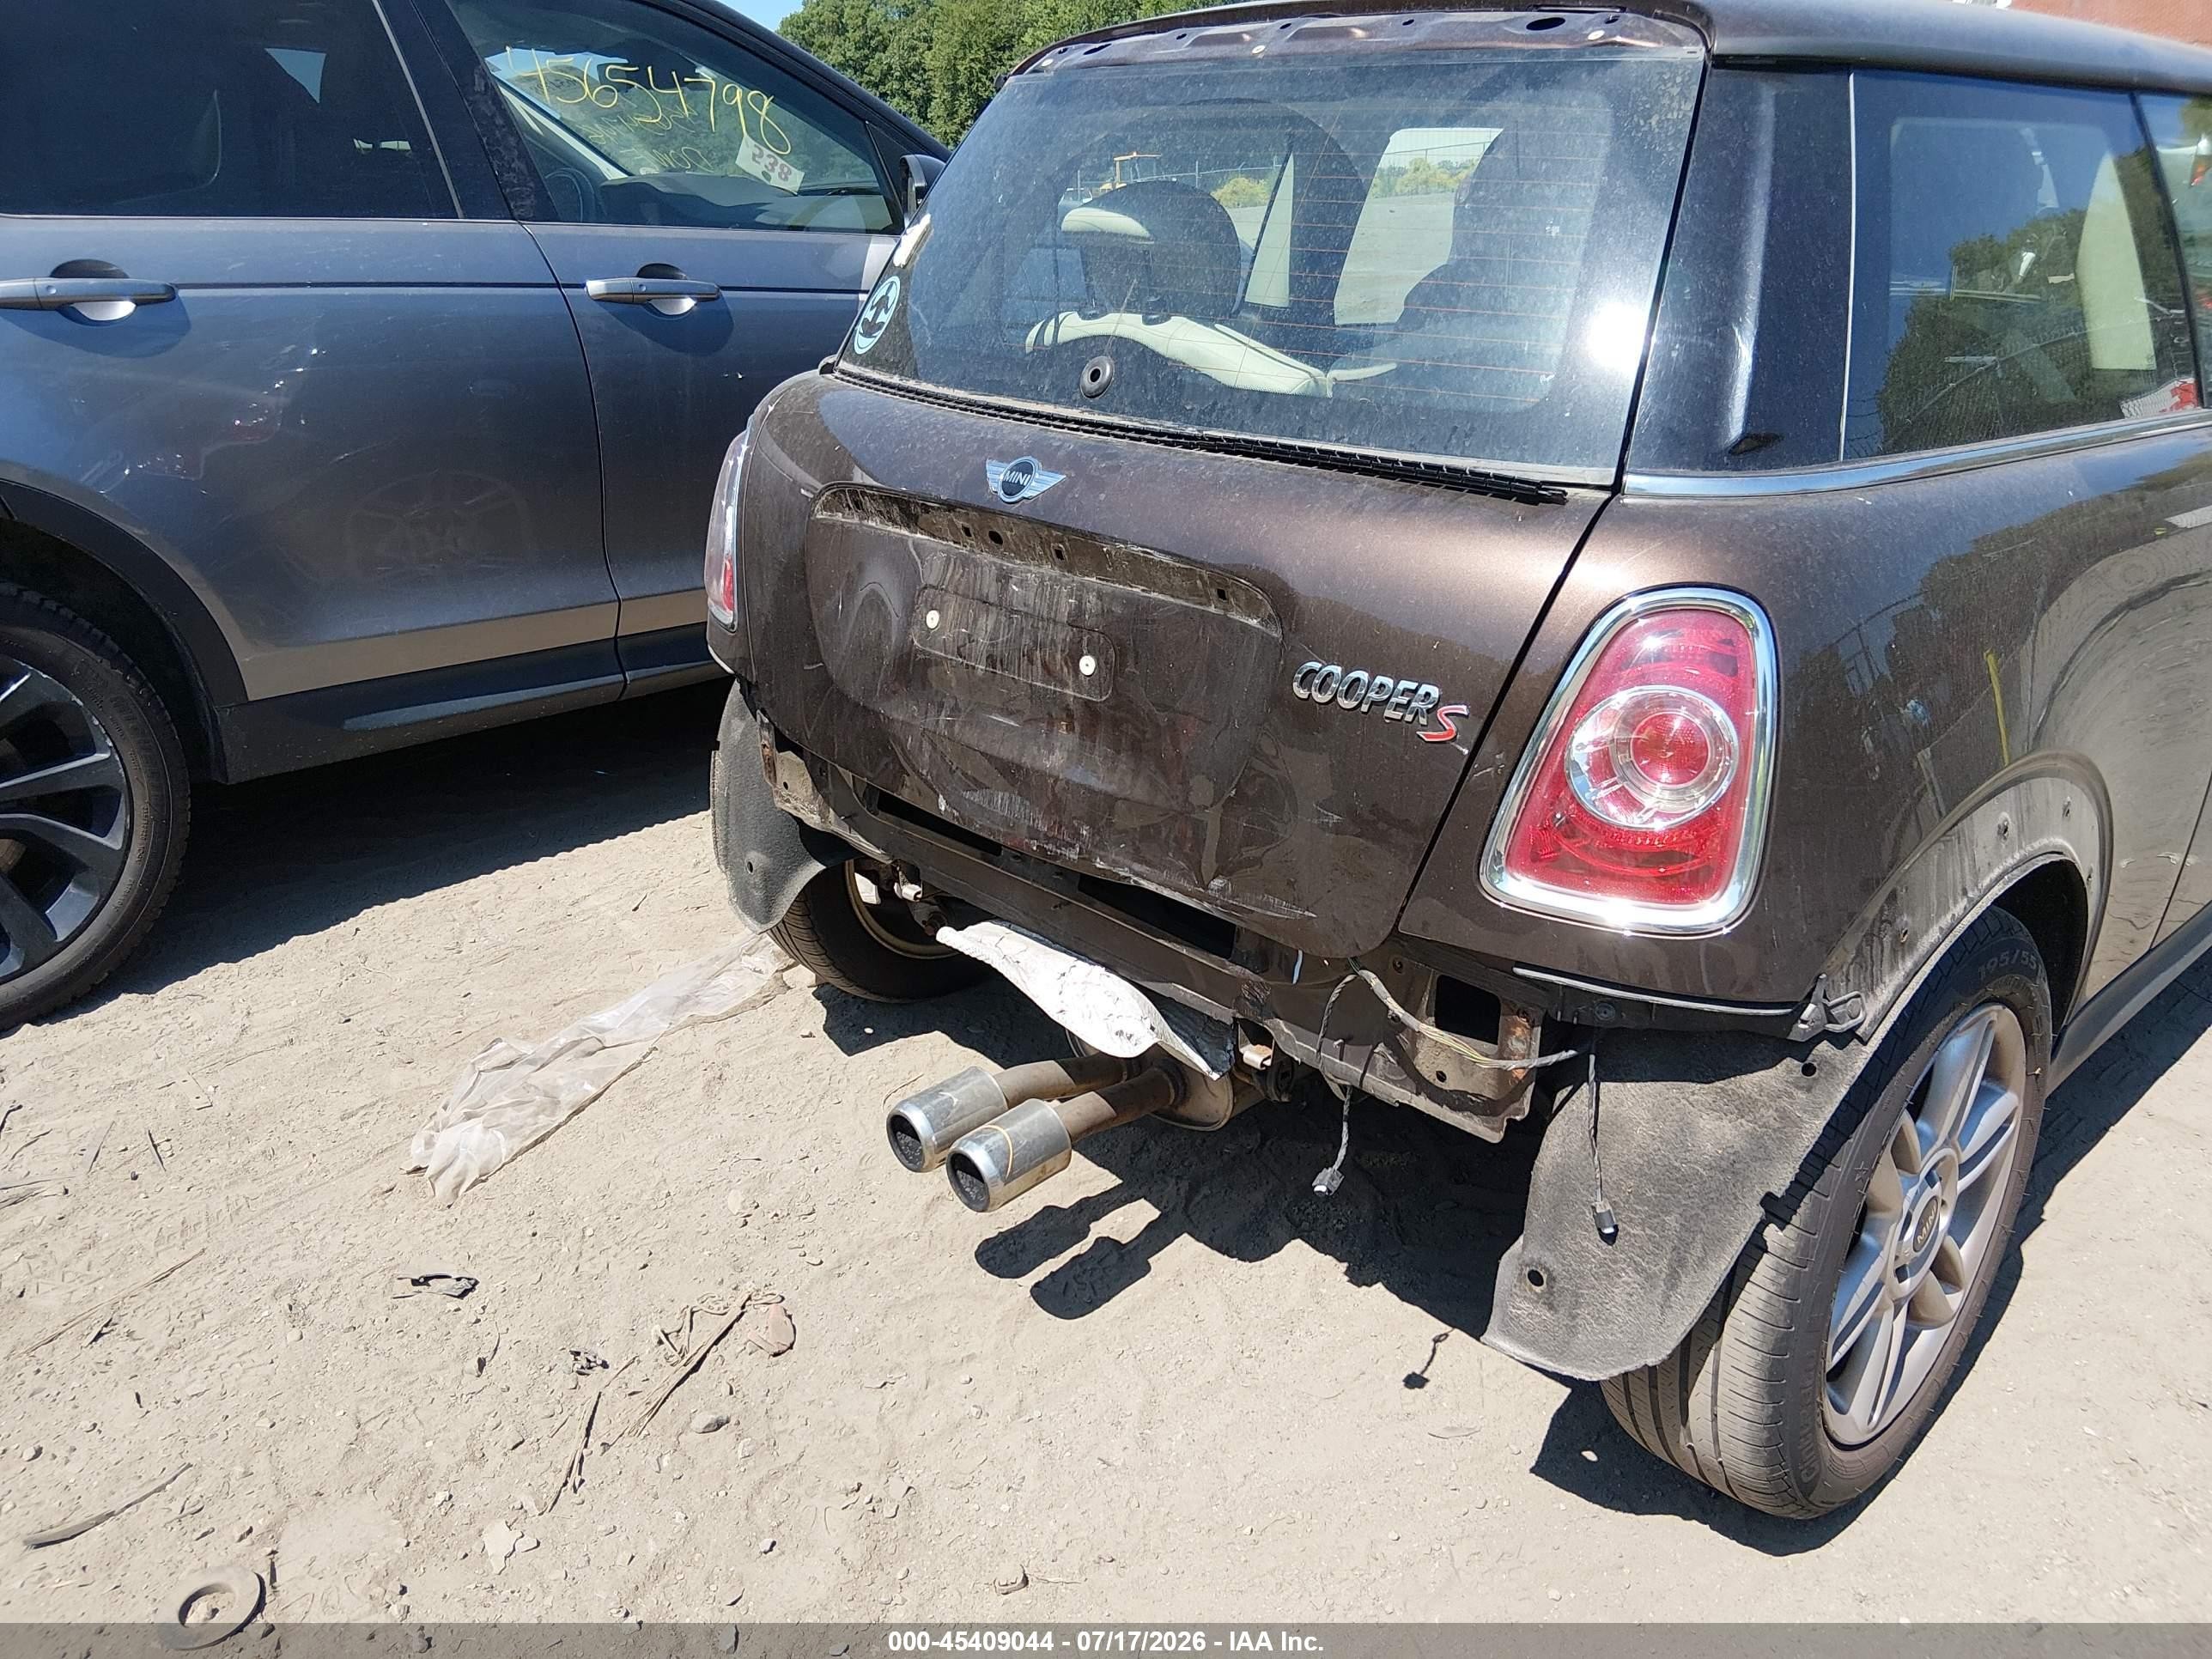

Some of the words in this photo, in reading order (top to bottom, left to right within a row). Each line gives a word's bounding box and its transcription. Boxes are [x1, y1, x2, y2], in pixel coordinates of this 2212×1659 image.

[1003, 471, 1031, 486] MINI
[1292, 661, 1440, 726] COOPER
[1416, 704, 1469, 742] S
[1917, 1206, 1937, 1244] MINI
